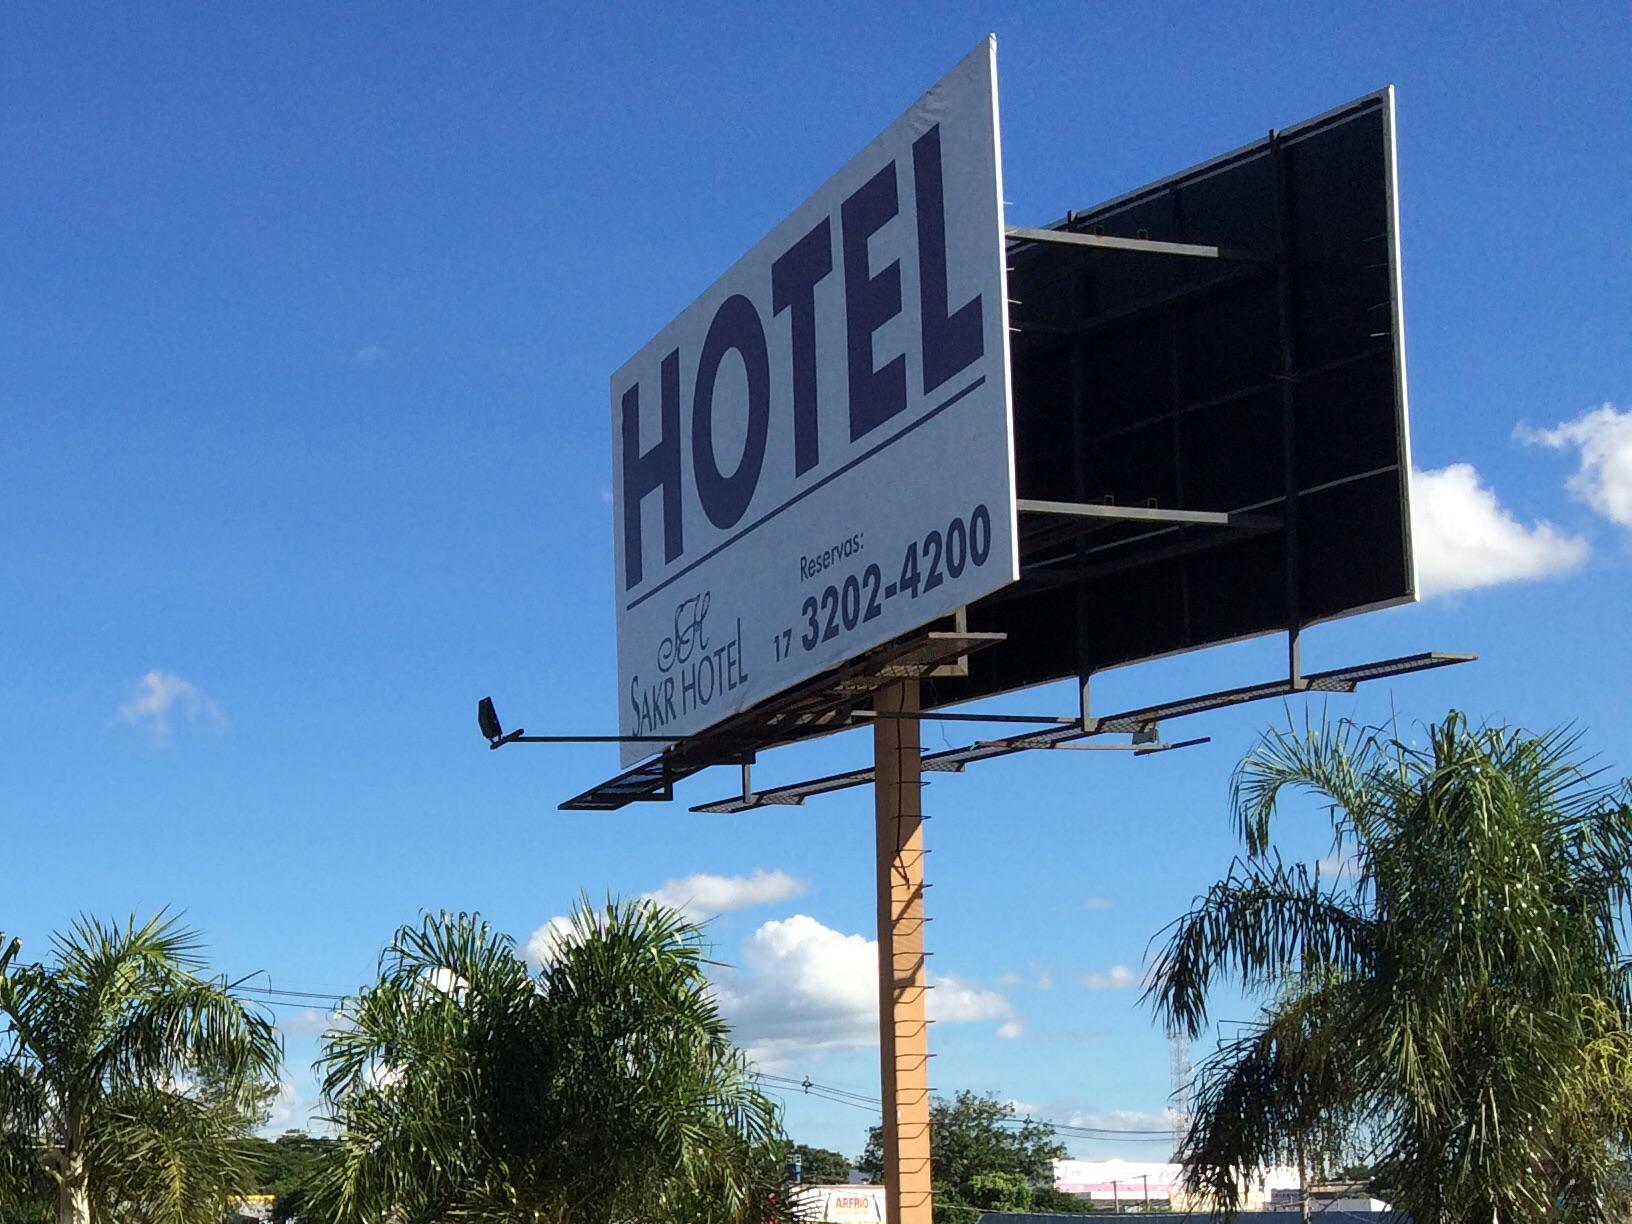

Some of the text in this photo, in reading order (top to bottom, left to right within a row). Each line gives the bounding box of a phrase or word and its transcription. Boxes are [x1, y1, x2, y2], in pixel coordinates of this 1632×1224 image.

[622, 123, 984, 591] HOTEL
[774, 503, 992, 662] 17 3202-4200
[799, 532, 865, 583] Reservas:
[631, 617, 749, 737] SAKR HOTEL
